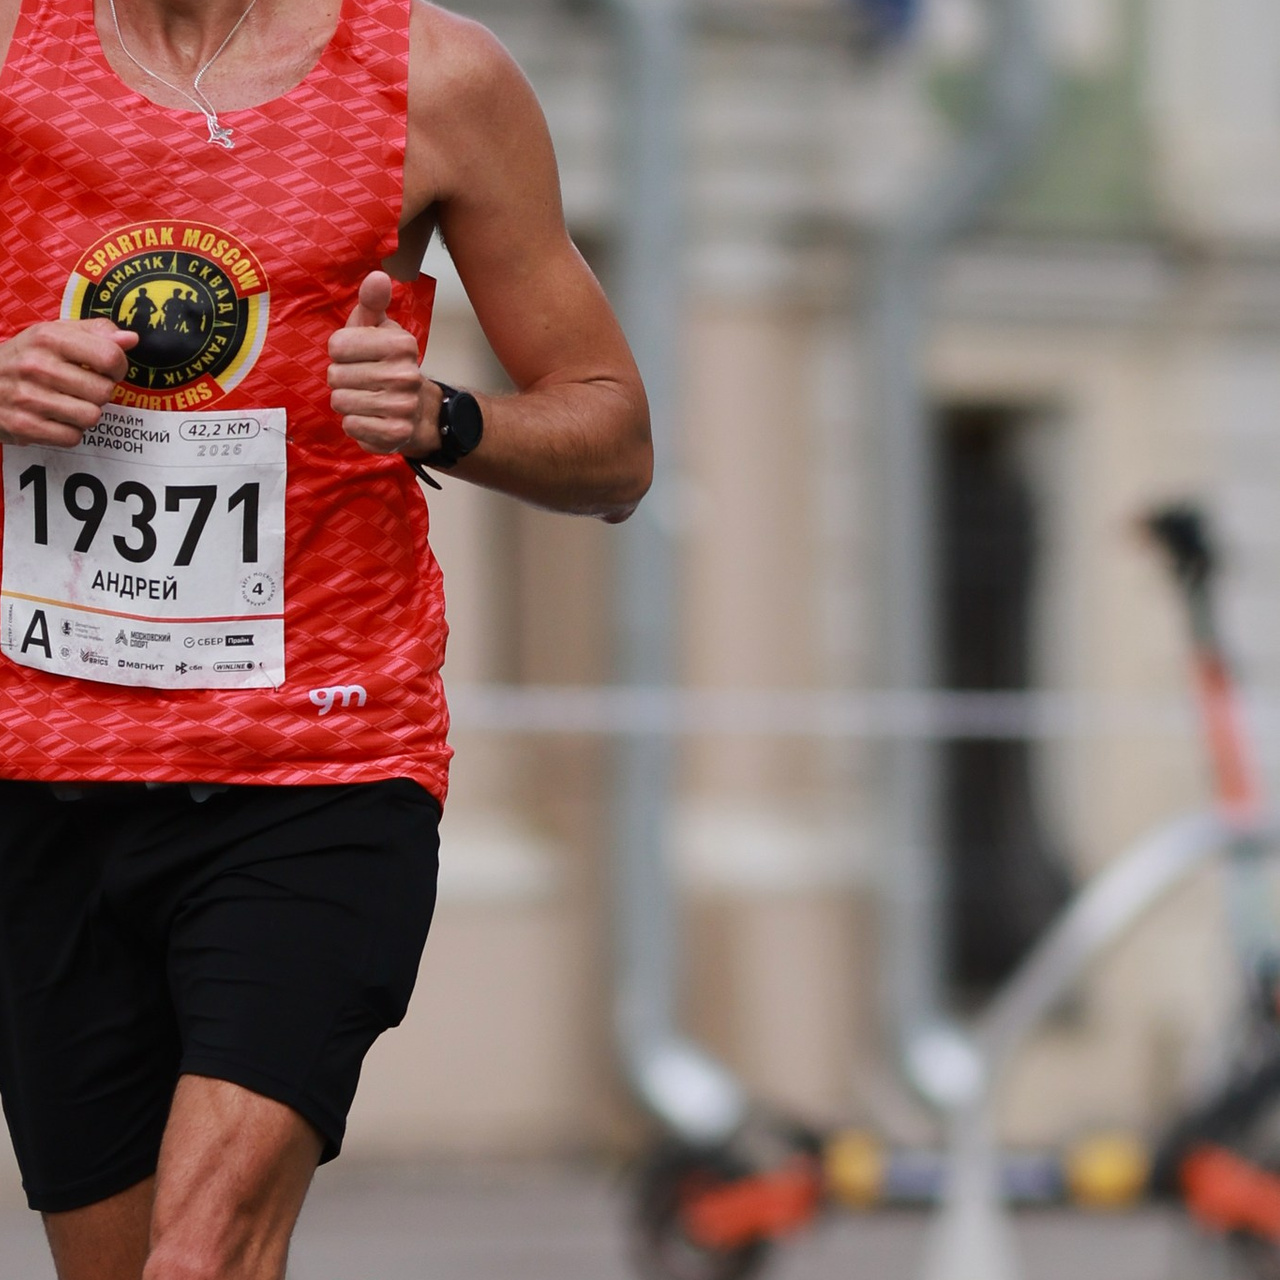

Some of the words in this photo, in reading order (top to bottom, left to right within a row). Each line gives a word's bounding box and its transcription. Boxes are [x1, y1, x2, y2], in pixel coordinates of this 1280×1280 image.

[84, 226, 174, 277] SPARTAK
[181, 227, 261, 292] MOSCOW
[187, 260, 234, 315] СКВАД
[110, 382, 213, 411] PPORTERS
[100, 412, 144, 427] ПРАЙМ
[187, 422, 222, 437] 42,2
[84, 423, 171, 444] ОСКОВСКИЙ
[196, 443, 244, 457] 2026
[19, 463, 260, 567] 19371
[91, 569, 178, 601] АНДРЕЙ
[252, 582, 264, 596] 4
[197, 637, 224, 647] СБЕР
